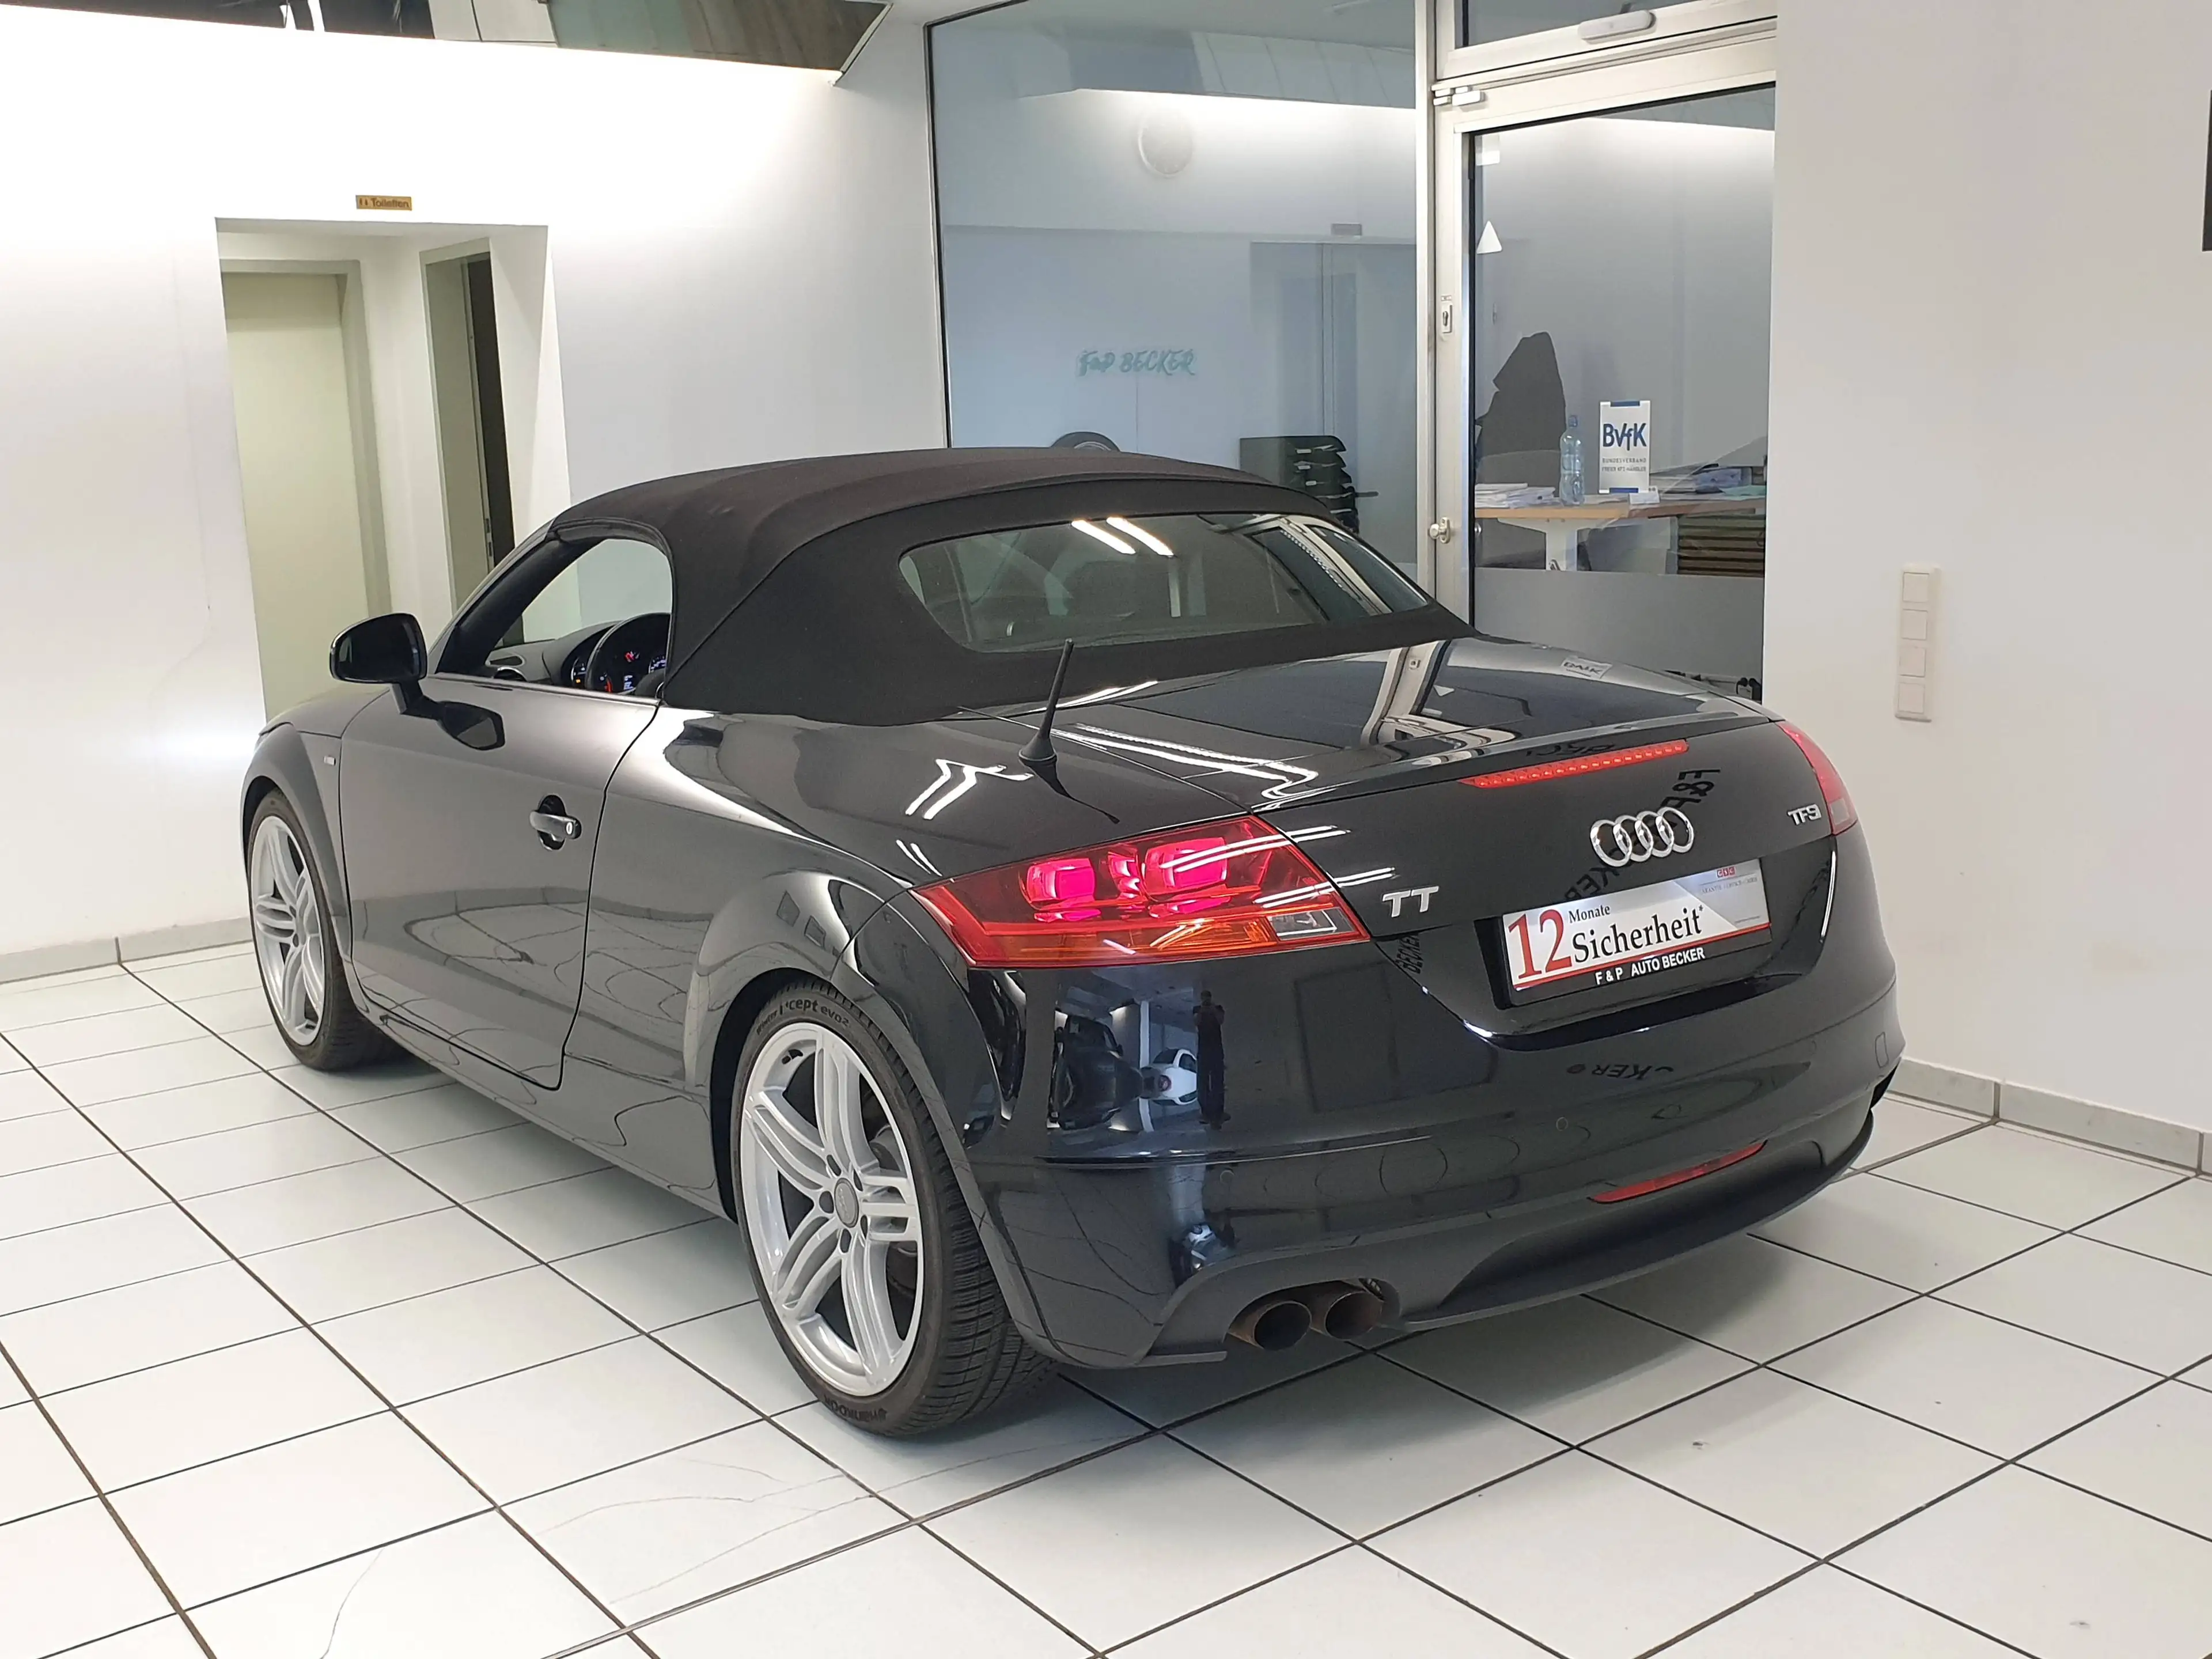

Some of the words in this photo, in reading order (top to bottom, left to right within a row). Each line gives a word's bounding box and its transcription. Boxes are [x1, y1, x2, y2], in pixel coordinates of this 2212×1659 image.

[370, 198, 410, 208] Toiletten
[1119, 348, 1196, 376] BECKER
[1603, 423, 1647, 451] BVfK
[1382, 886, 1439, 918] TT
[1569, 904, 1611, 923] Monate
[1508, 909, 1572, 979] 12
[1631, 957, 1660, 977] AUTO
[1662, 947, 1706, 969] BECKER
